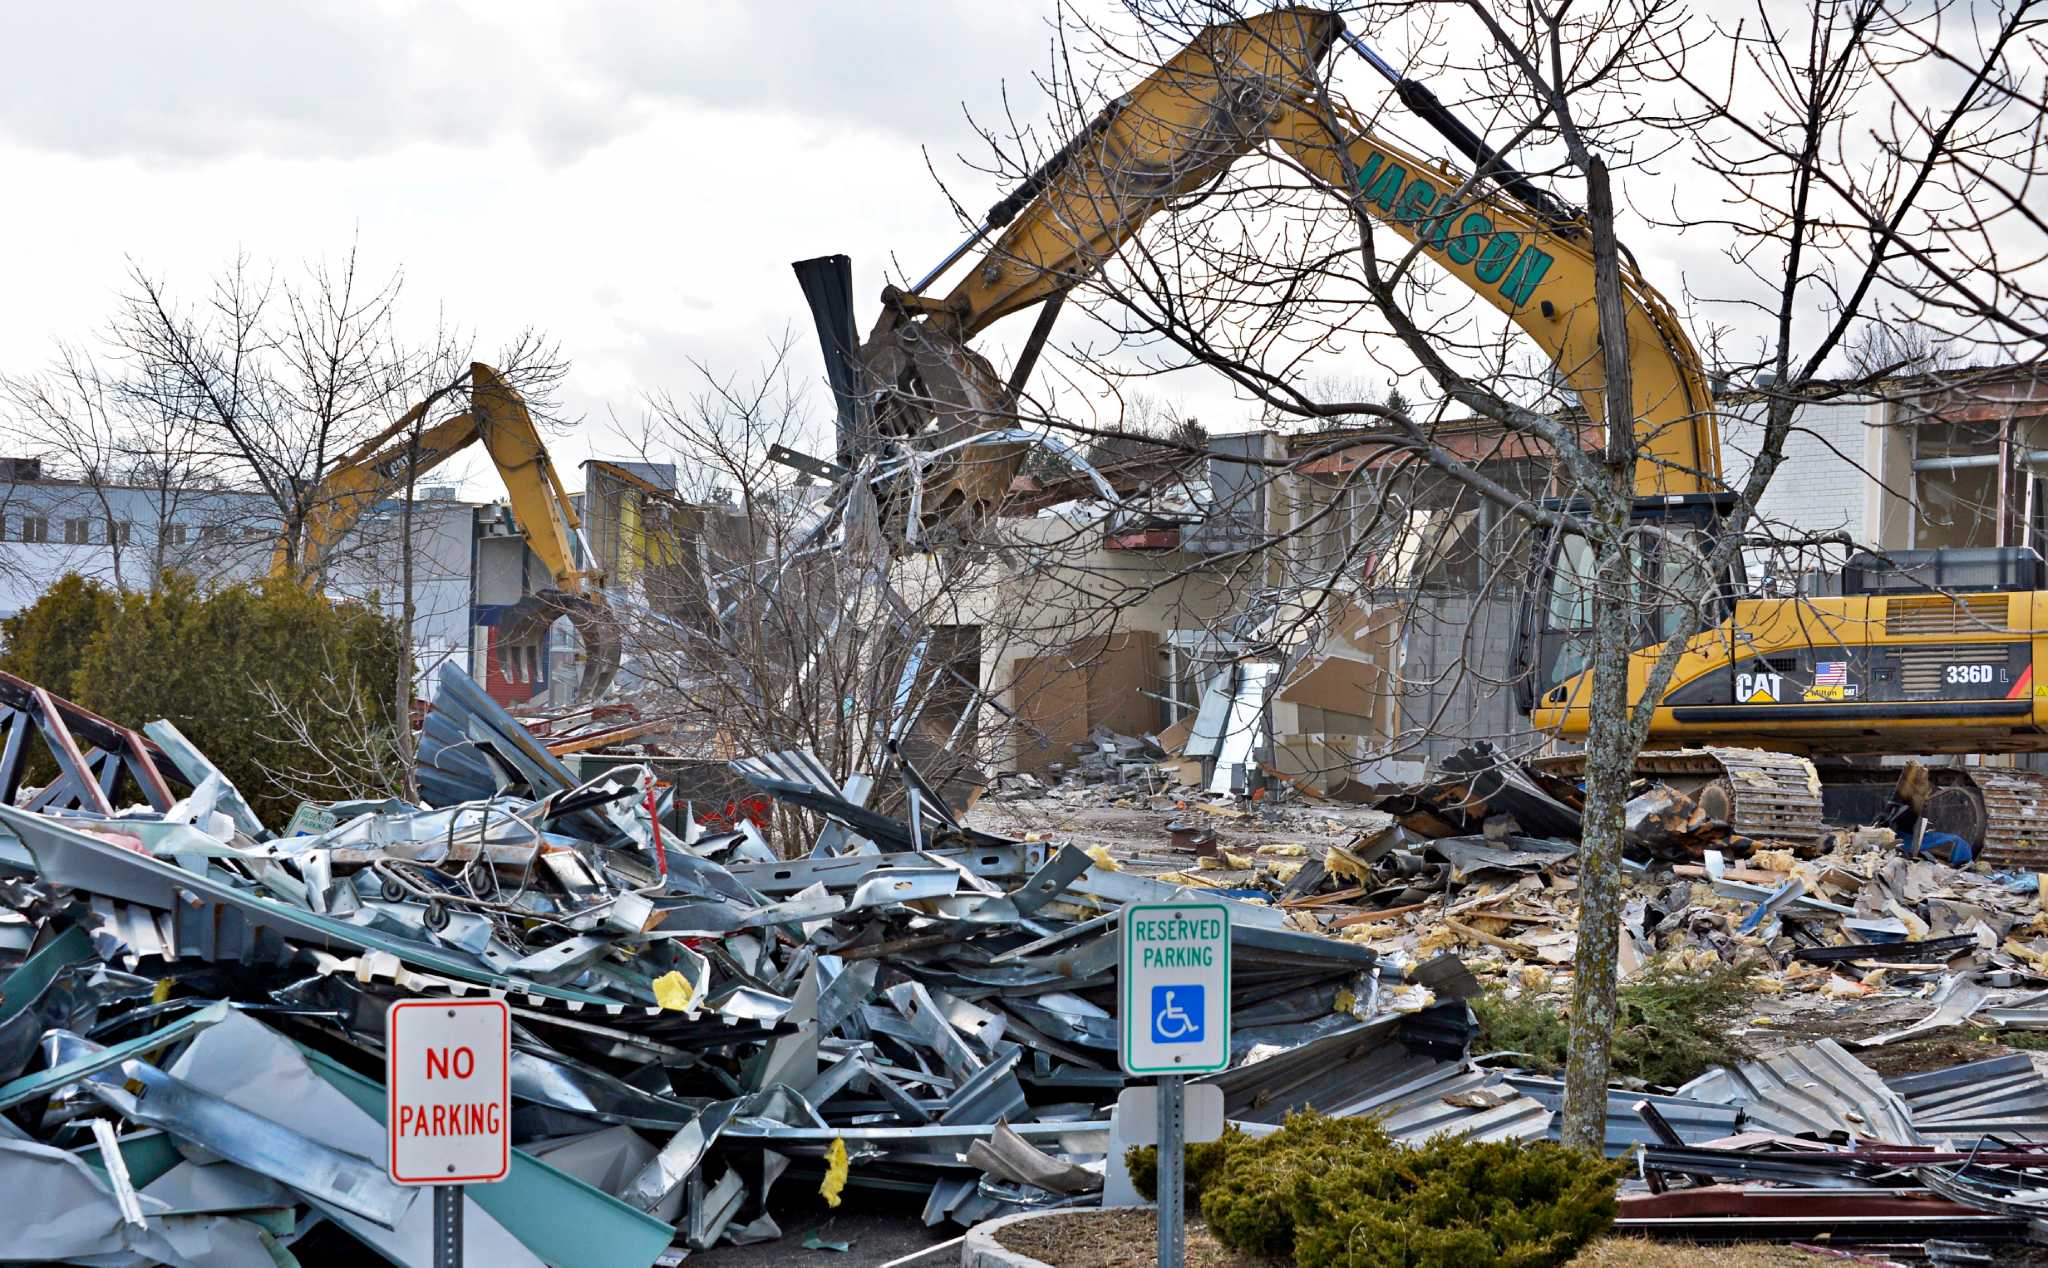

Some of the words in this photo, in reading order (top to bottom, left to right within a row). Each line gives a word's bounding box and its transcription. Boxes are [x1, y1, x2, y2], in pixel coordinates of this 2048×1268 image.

[1342, 151, 1555, 308] JACKSON
[1736, 673, 1784, 703] CAT
[1946, 664, 1993, 683] 336D
[2000, 668, 2009, 683] L
[1136, 919, 1220, 942] RESERVED
[1143, 946, 1213, 969] PARKING
[426, 1046, 475, 1080] NO
[400, 1103, 500, 1137] PARKING
